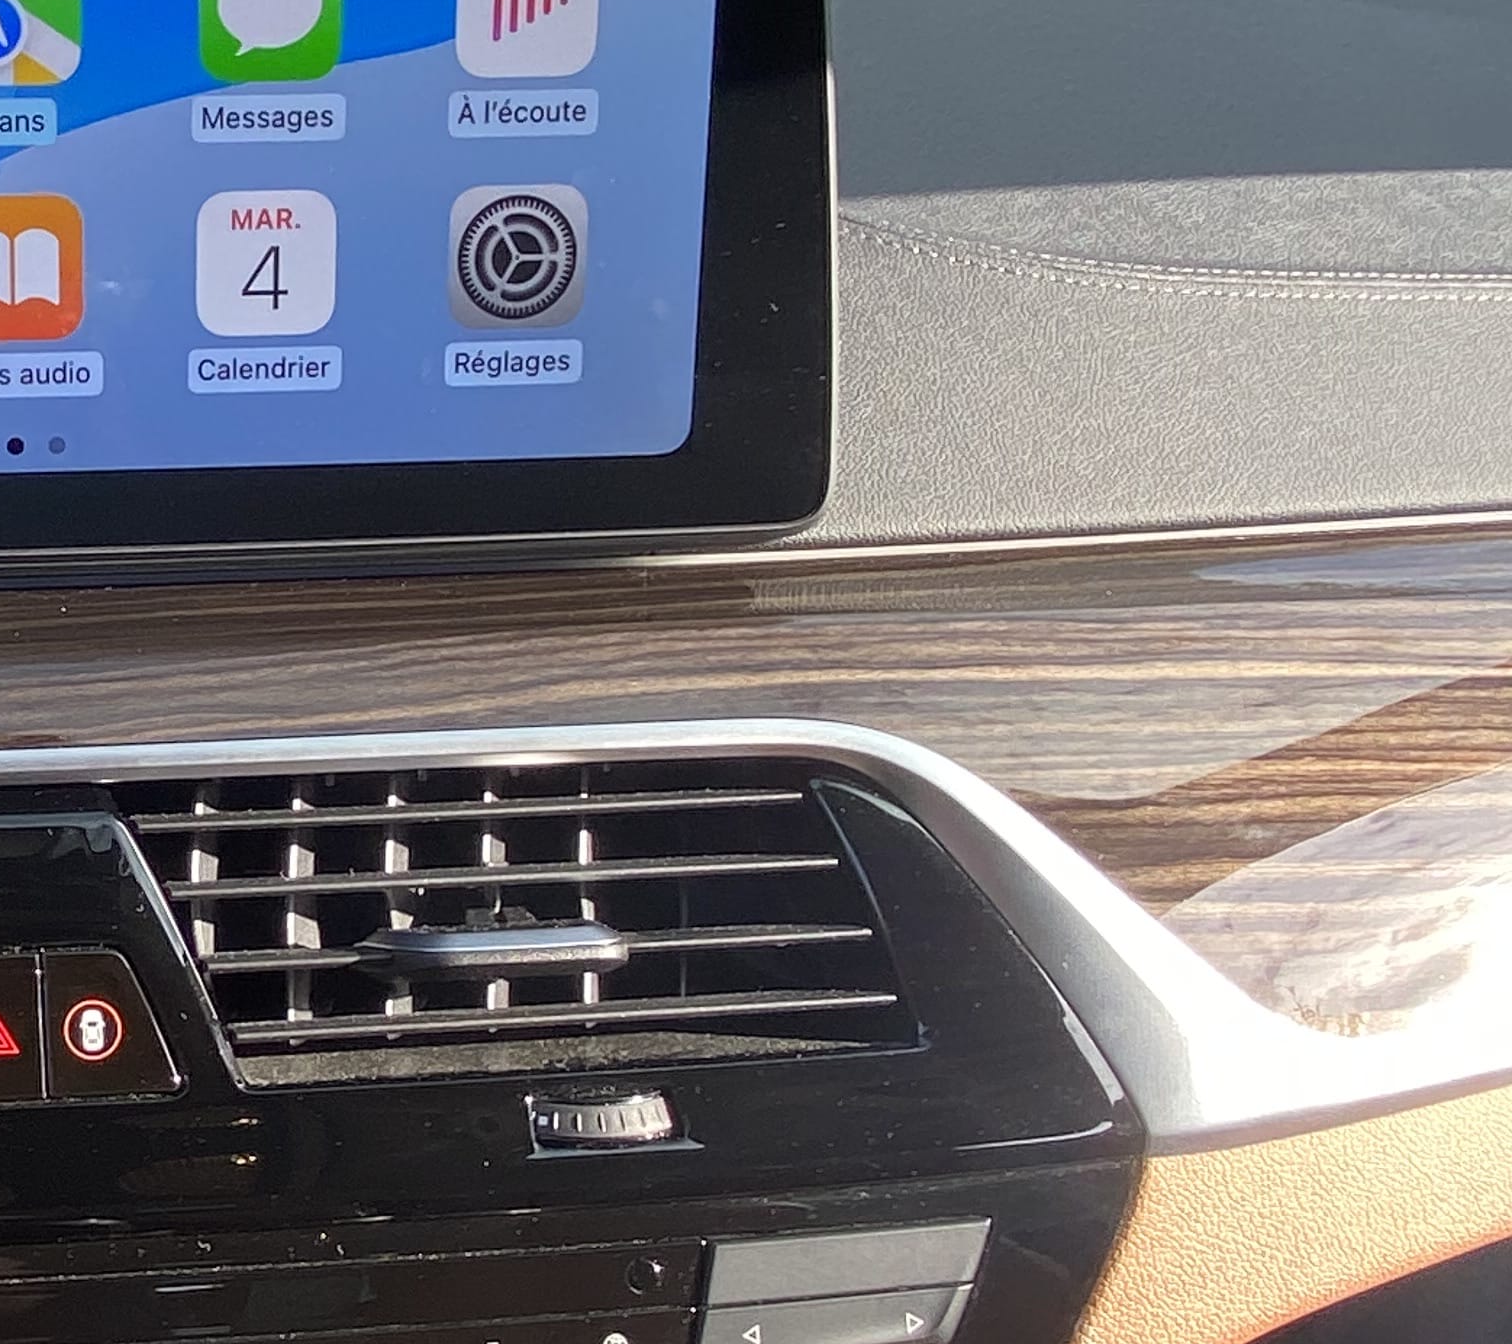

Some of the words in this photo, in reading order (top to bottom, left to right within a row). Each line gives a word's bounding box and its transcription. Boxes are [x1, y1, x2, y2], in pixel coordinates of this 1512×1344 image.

[201, 105, 334, 135] Messages
[457, 94, 478, 124] À
[230, 207, 302, 232] MAR.
[241, 244, 288, 311] 4
[19, 362, 91, 385] audio
[198, 356, 331, 383] Calendrier
[454, 350, 570, 379] Réglages
